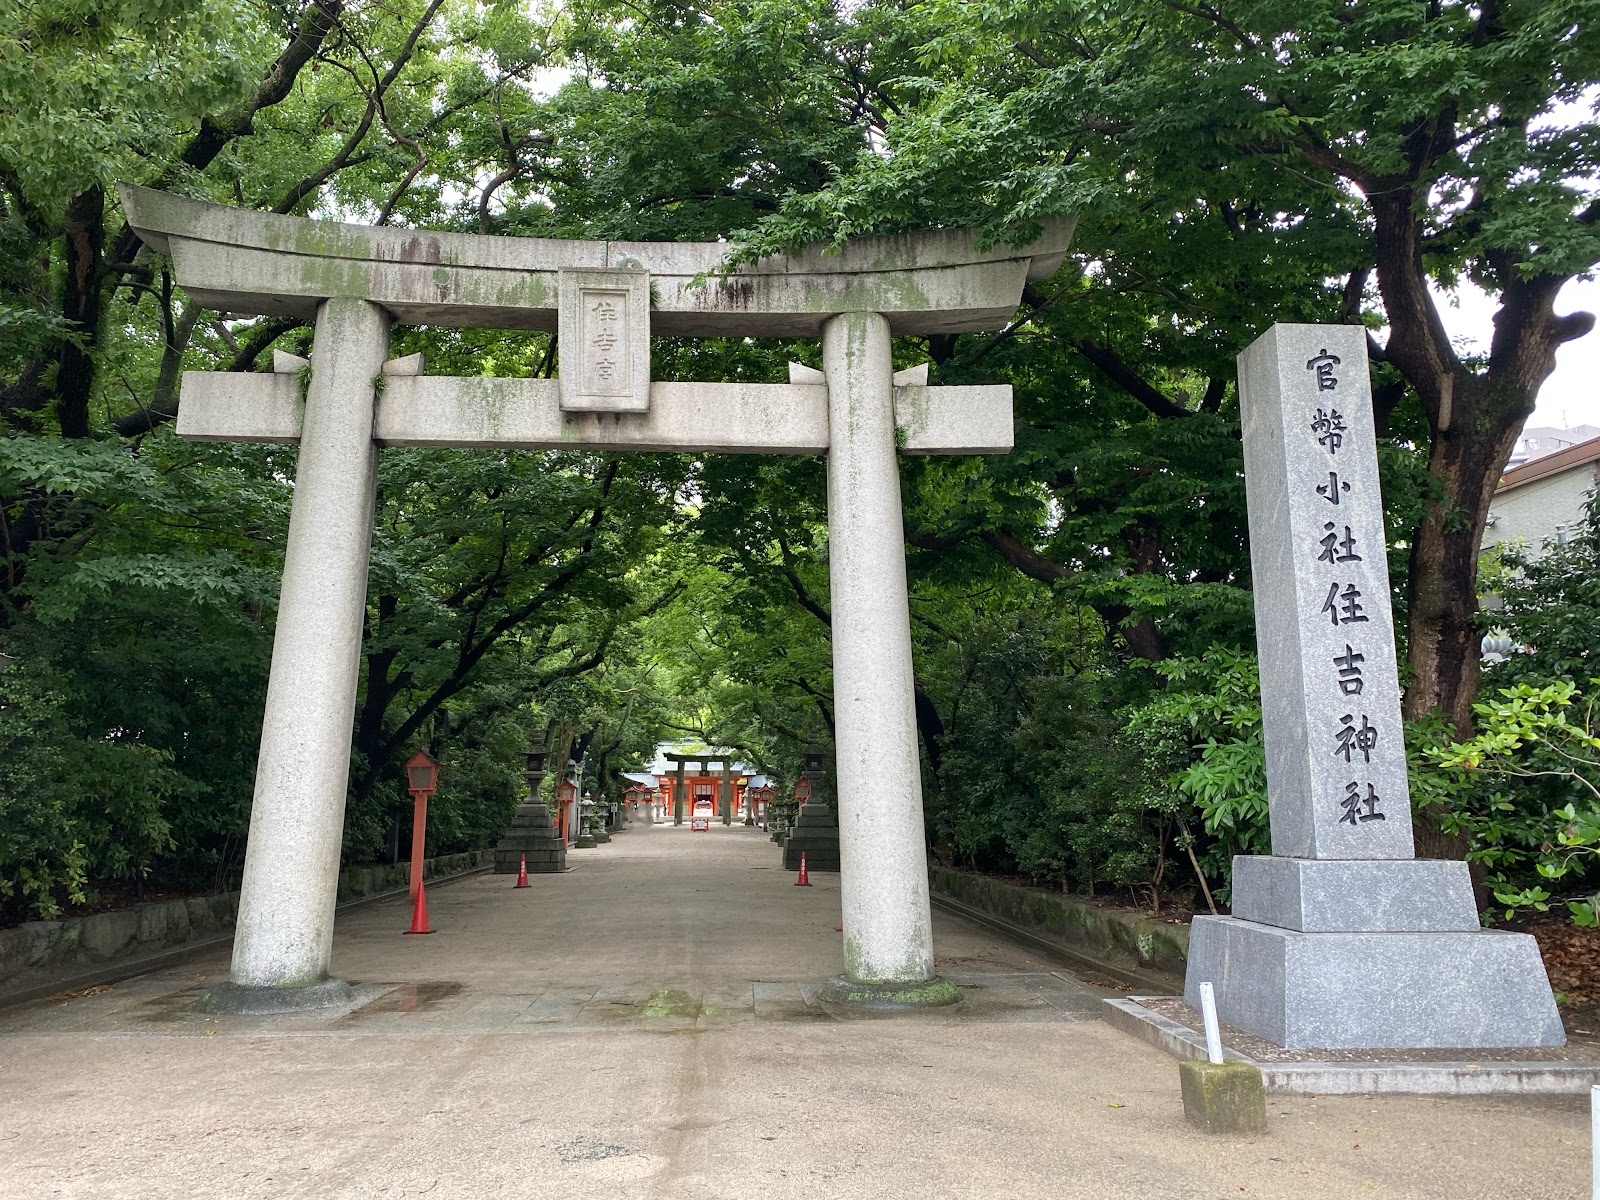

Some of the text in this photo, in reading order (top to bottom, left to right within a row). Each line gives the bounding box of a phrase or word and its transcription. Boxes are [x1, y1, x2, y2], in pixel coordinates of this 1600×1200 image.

[591, 302, 618, 380] 住吉宮
[1306, 348, 1386, 826] 官幣小社住吉神社
